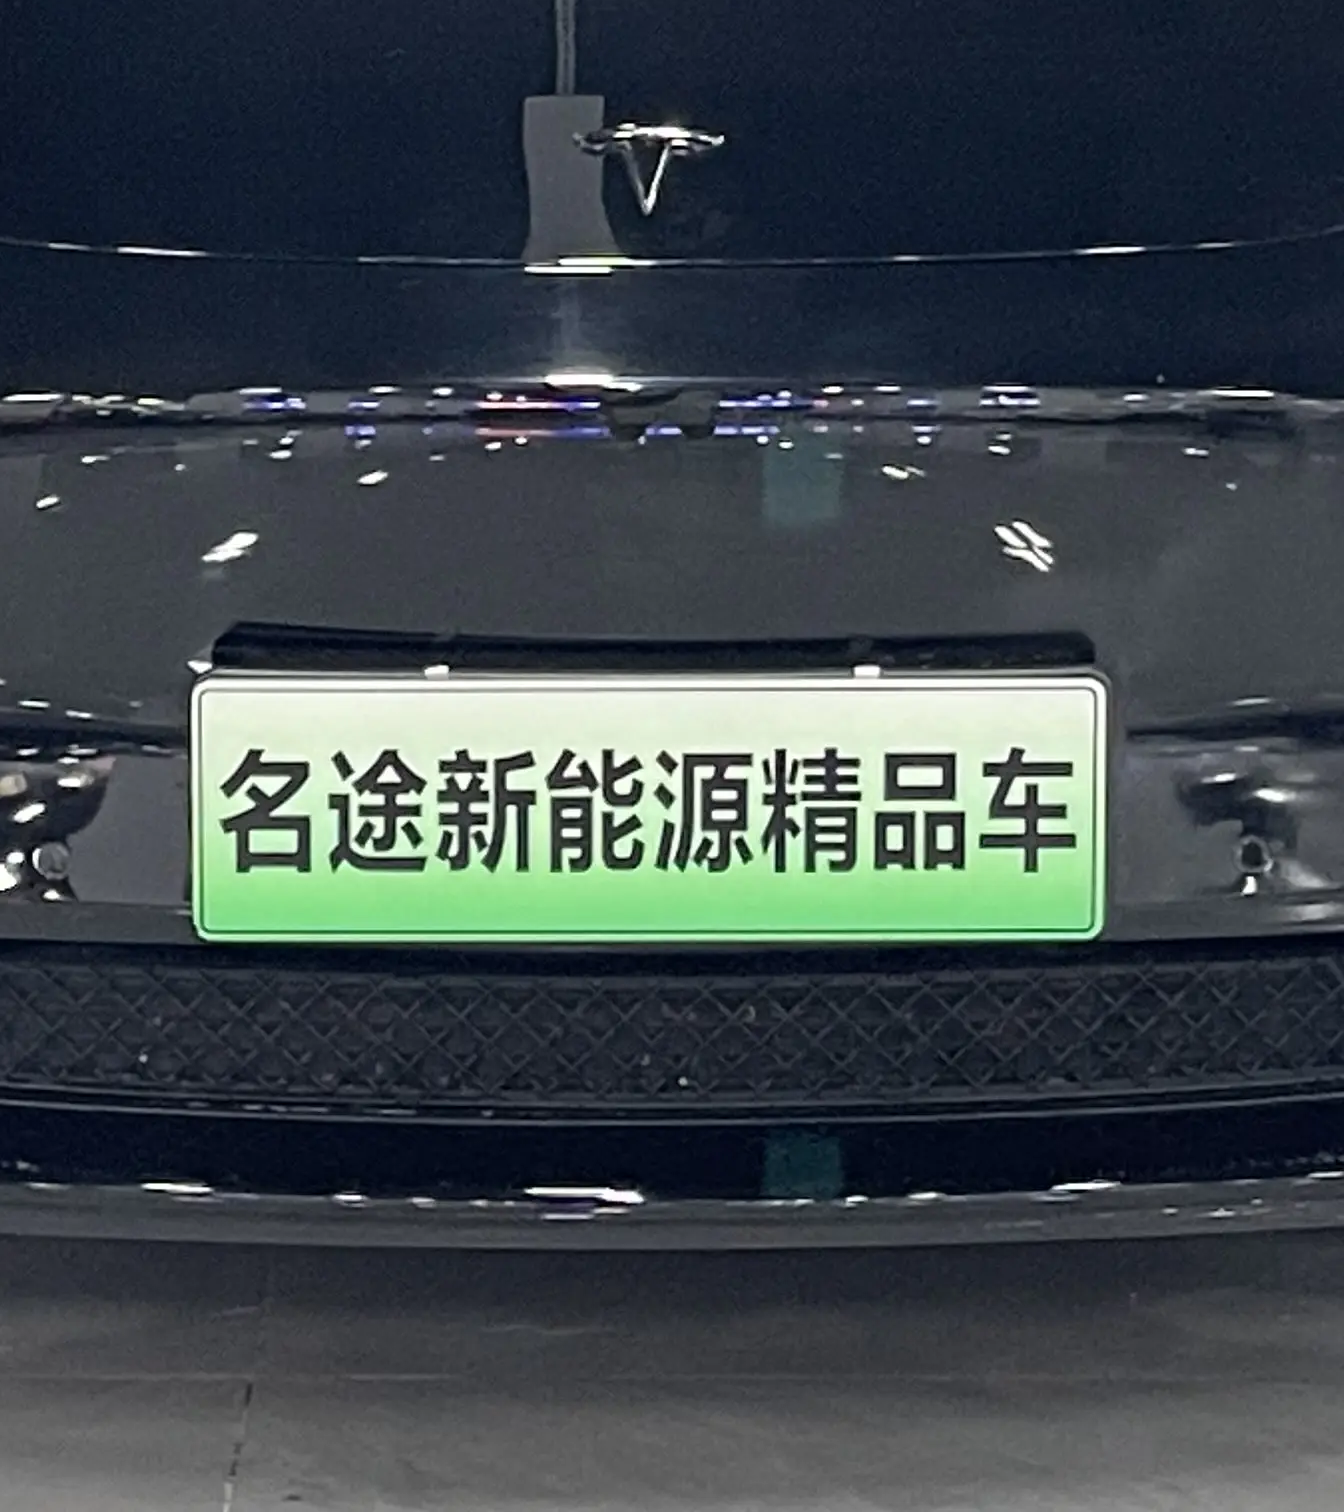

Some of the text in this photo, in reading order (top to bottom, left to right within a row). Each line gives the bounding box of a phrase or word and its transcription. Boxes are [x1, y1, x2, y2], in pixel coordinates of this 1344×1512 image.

[218, 748, 1077, 874] 名途新能源精品车
